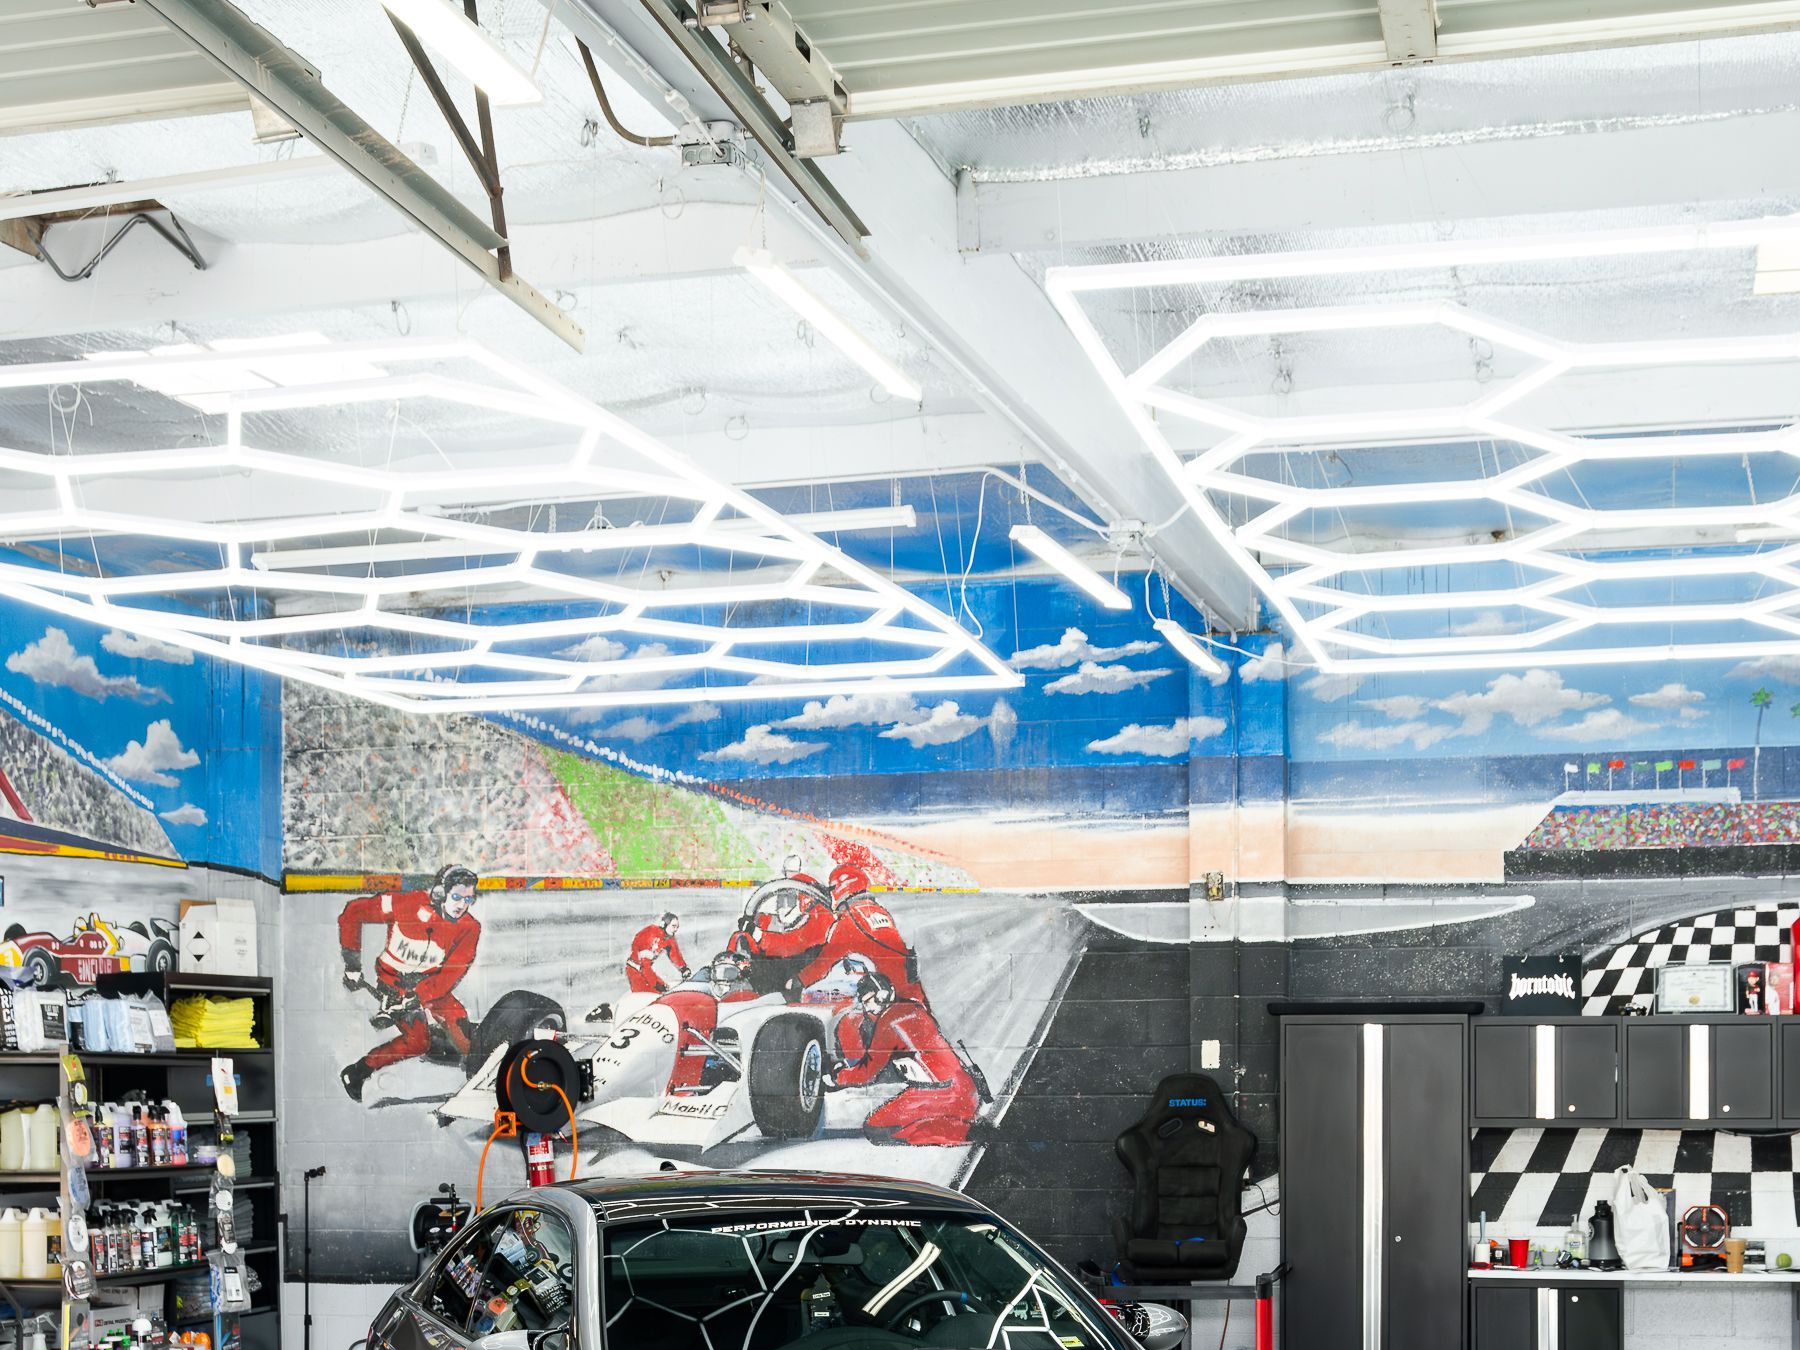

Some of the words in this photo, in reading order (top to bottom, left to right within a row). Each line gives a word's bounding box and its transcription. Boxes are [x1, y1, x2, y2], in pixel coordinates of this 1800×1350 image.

[610, 1028, 640, 1049] 3
[711, 1219, 841, 1234] PERFORMANCE
[845, 1219, 922, 1227] DYNAMIC
